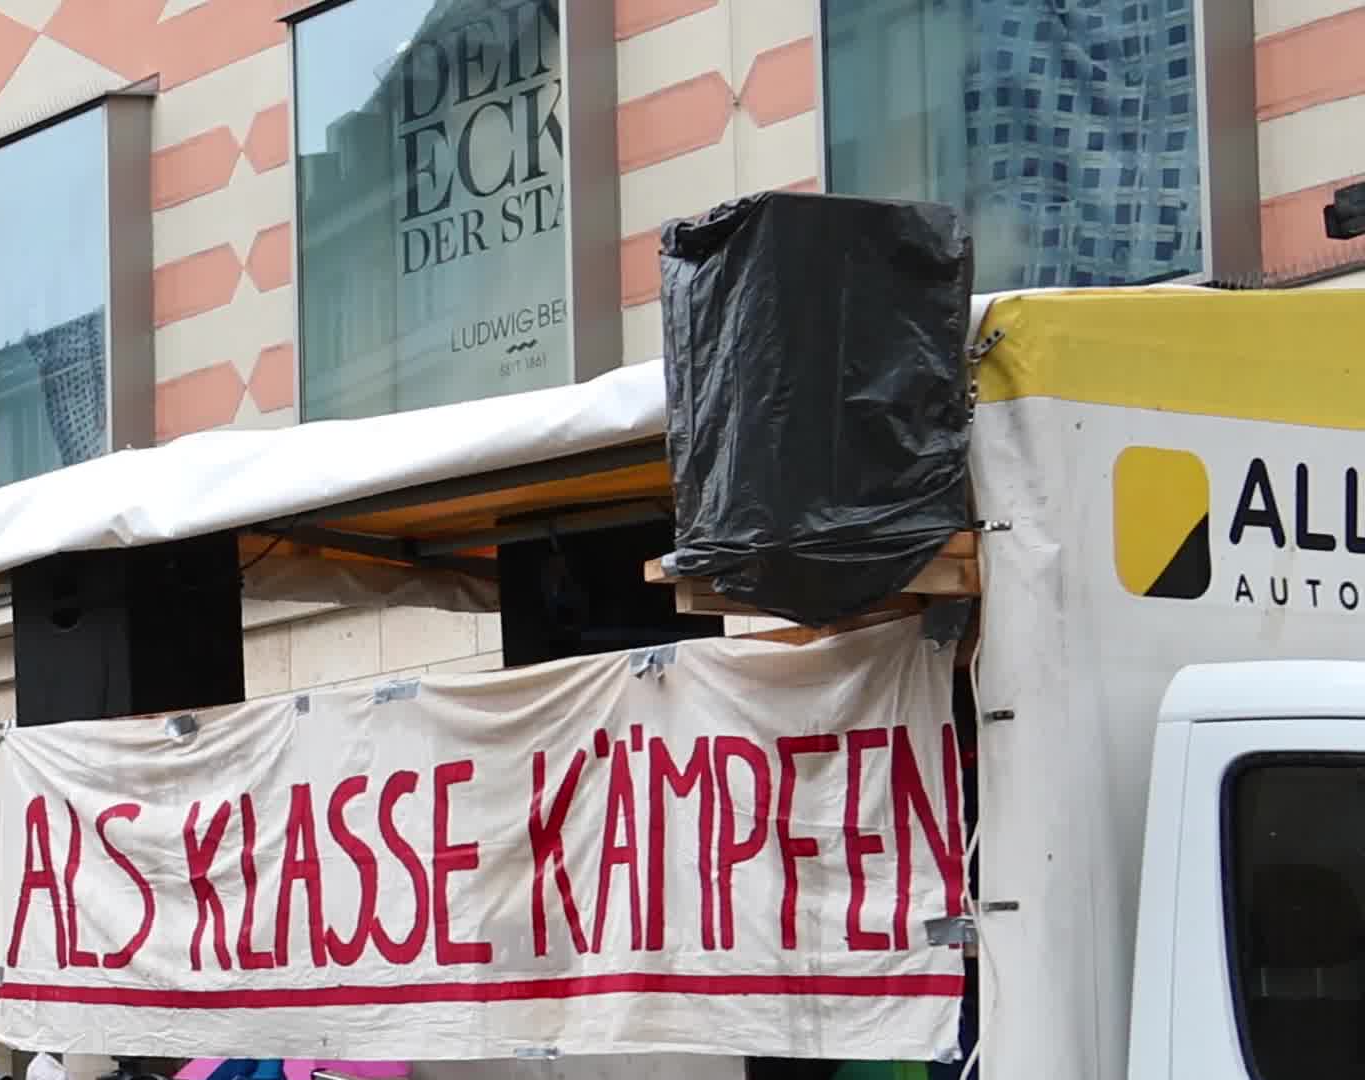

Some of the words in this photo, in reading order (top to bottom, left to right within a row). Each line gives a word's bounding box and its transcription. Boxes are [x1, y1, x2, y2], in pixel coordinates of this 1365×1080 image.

[398, 79, 563, 222] ECK
[402, 208, 490, 276] DER
[450, 307, 534, 353] LUDWIG
[537, 298, 568, 328] BE
[1235, 573, 1359, 611] AUTO
[7, 796, 155, 969] ALS
[184, 759, 493, 971] KLASSE
[529, 723, 965, 957] KÄMPFEN
